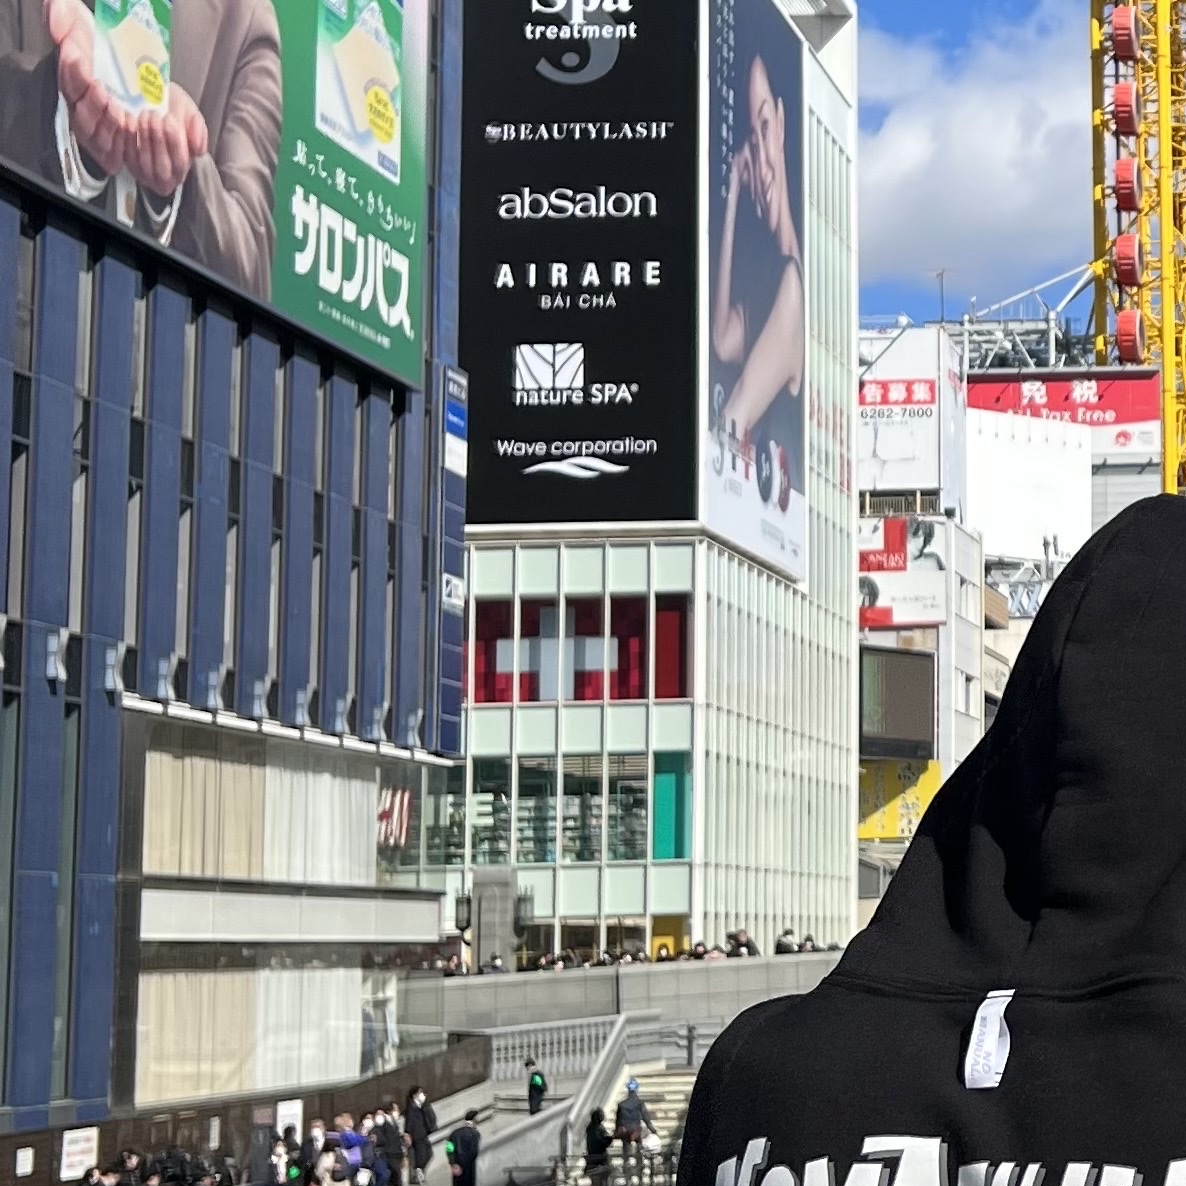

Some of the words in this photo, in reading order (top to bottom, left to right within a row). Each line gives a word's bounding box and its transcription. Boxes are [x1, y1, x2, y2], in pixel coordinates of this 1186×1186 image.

[524, 22, 637, 40] treatment
[502, 121, 668, 141] BEAUTYLASH
[497, 186, 657, 219] abSalon
[291, 184, 412, 338] サロンパス
[495, 261, 662, 289] AIRARE
[513, 387, 584, 406] nature
[1020, 379, 1099, 405] 免税
[1077, 406, 1117, 423] Free
[496, 438, 547, 457] Wave
[550, 436, 658, 457] corporation
